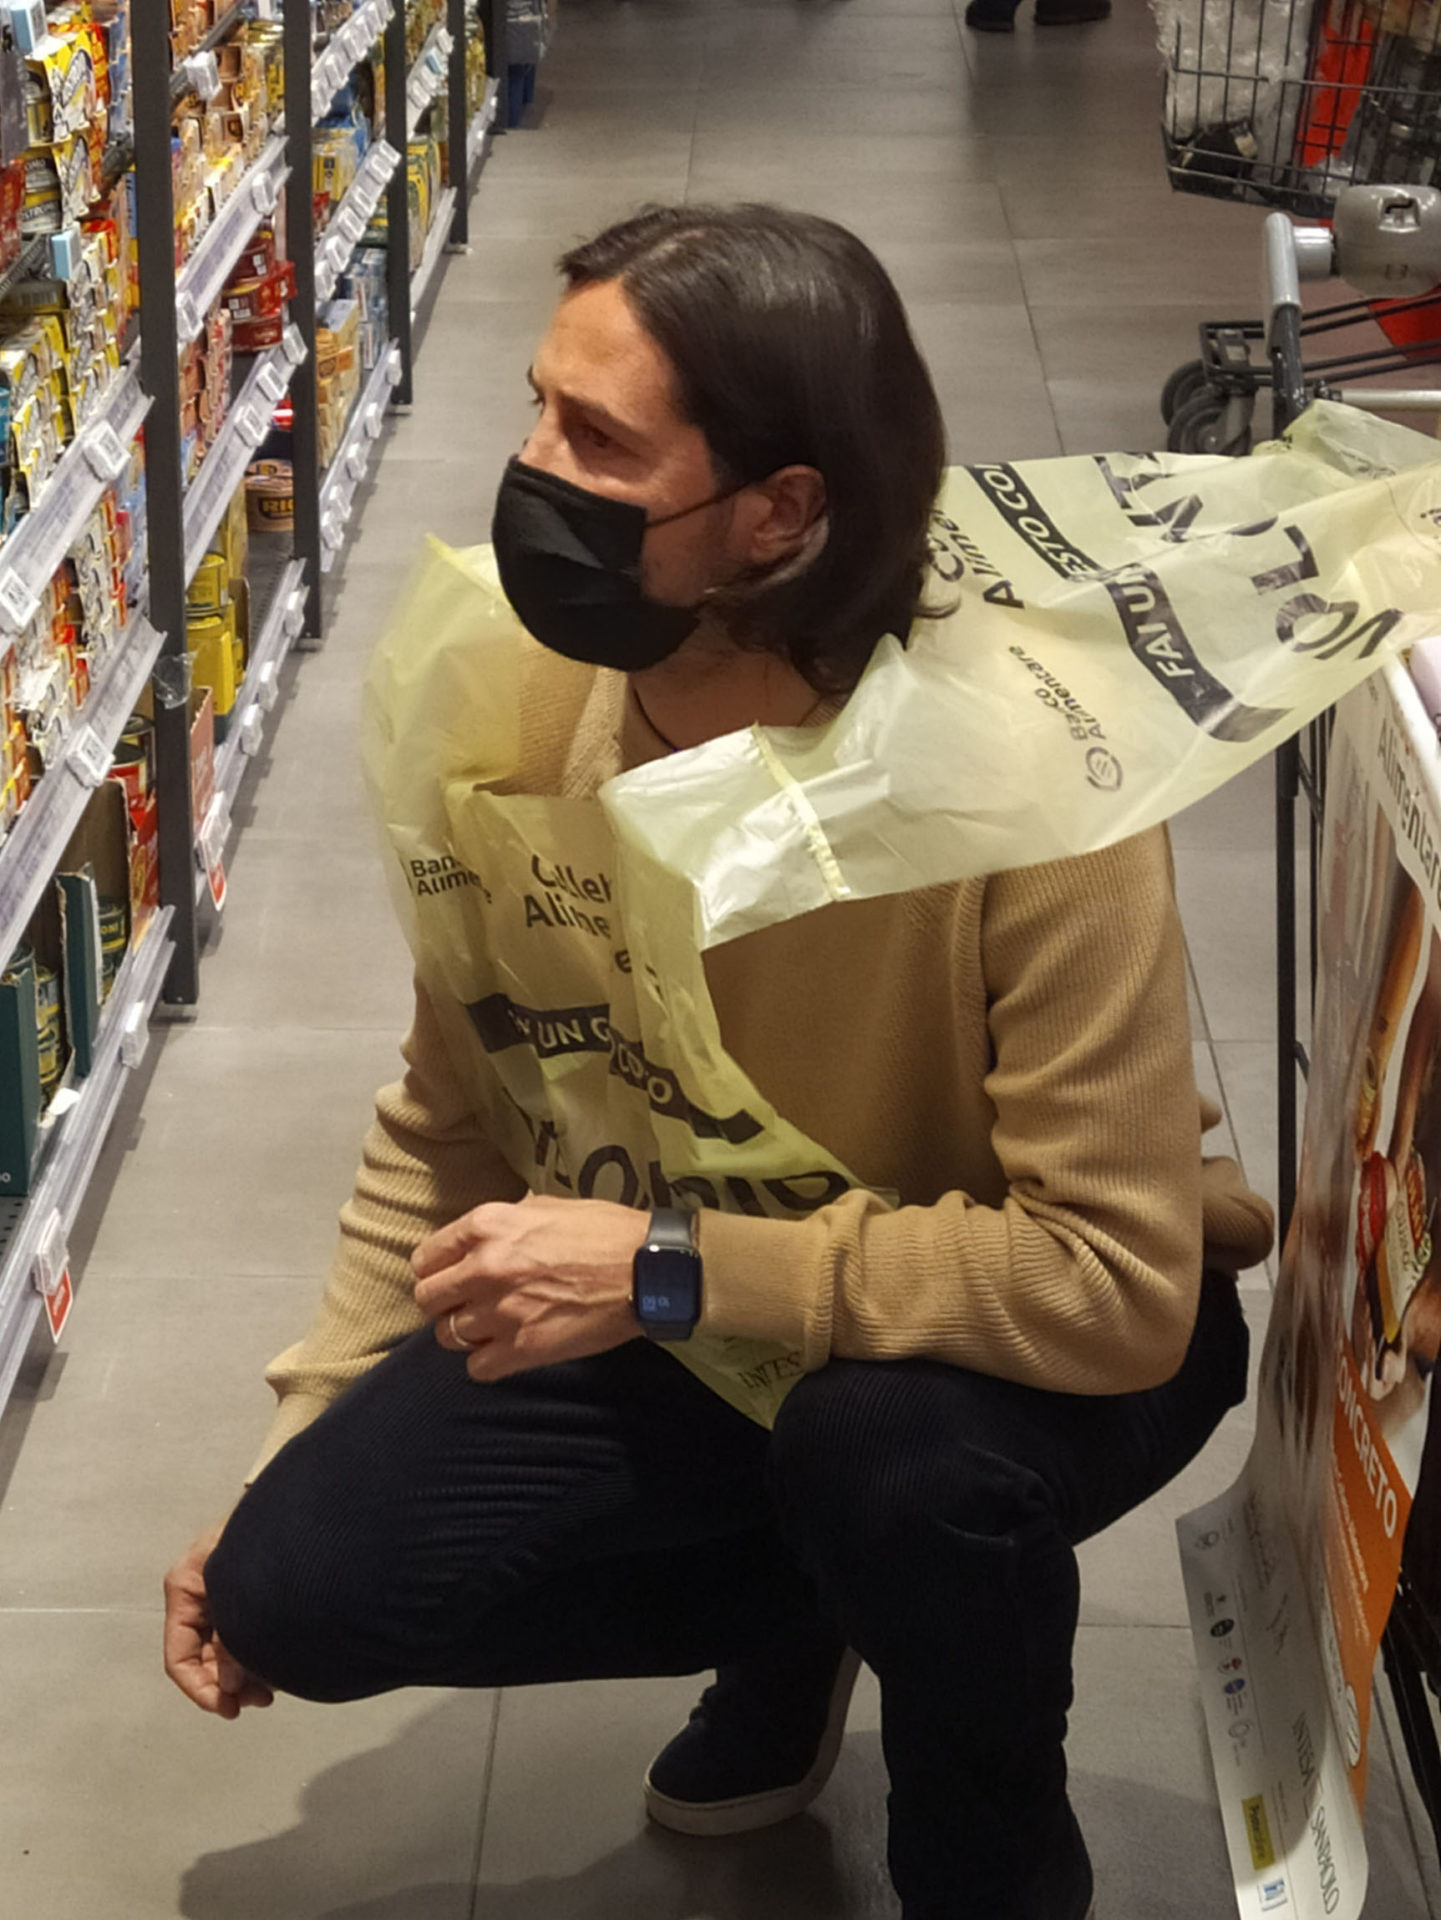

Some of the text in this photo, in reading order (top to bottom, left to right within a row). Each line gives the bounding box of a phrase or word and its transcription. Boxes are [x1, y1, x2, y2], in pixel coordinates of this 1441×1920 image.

[1018, 516, 1099, 575] ESTO
[1136, 621, 1195, 678] FAI
[411, 855, 458, 879] Ban
[537, 1018, 585, 1049] UN
[1337, 1355, 1398, 1540] ONCRETO
